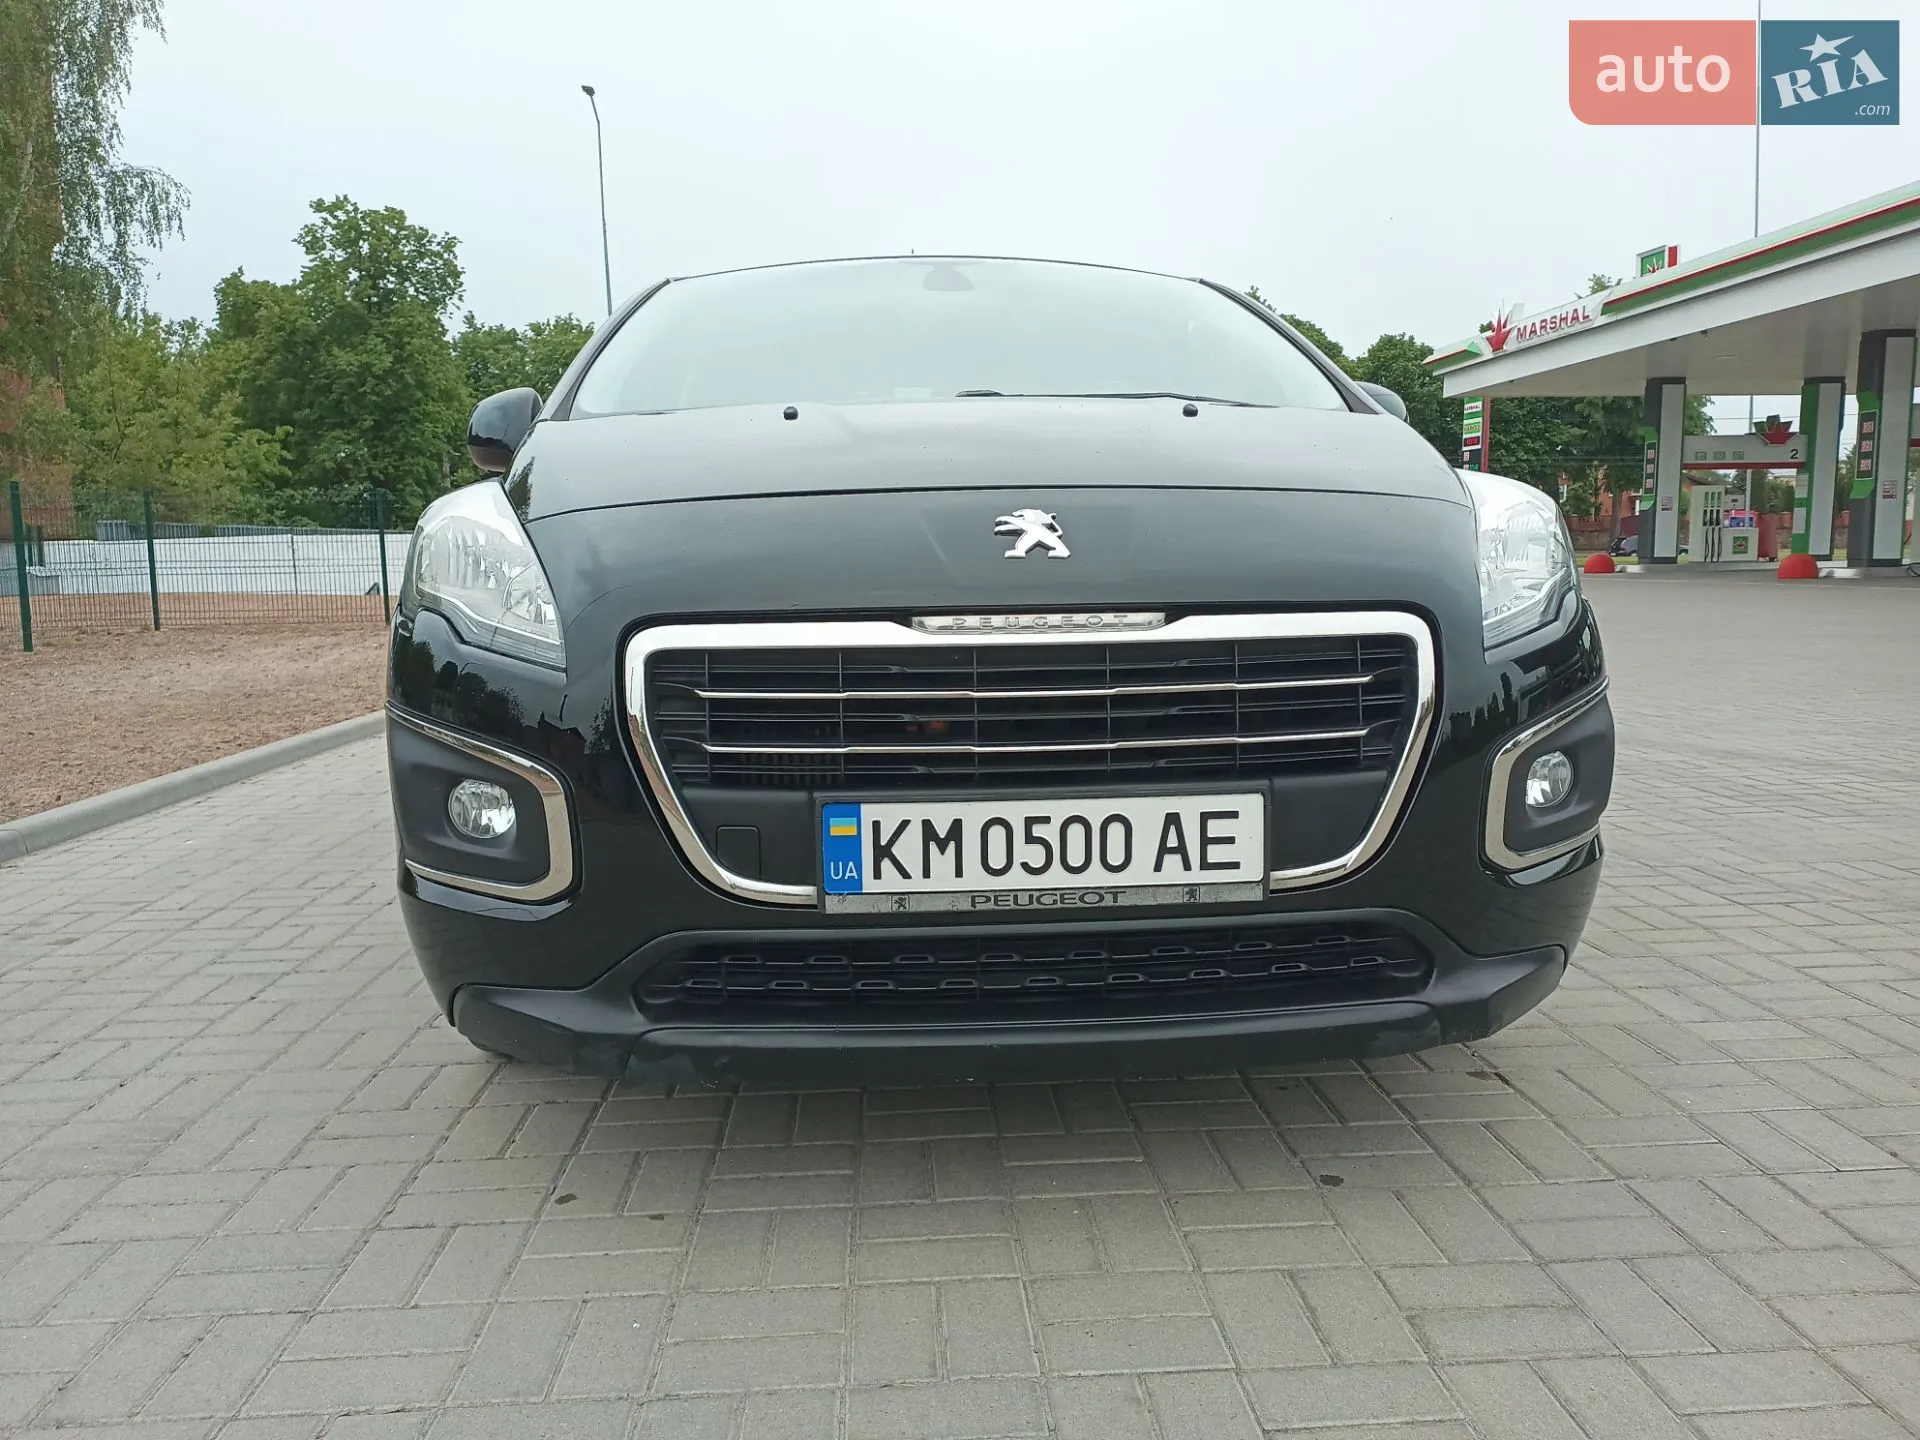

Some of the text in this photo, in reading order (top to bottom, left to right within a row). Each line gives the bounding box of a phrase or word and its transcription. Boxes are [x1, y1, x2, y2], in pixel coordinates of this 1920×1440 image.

[1516, 305, 1590, 342] MARSHAL
[1789, 448, 1799, 459] 2
[952, 614, 1128, 630] PEUGEOT
[871, 810, 1241, 880] KM 0500 AE
[830, 862, 858, 880] UA
[970, 890, 1127, 909] PEUGEOT
